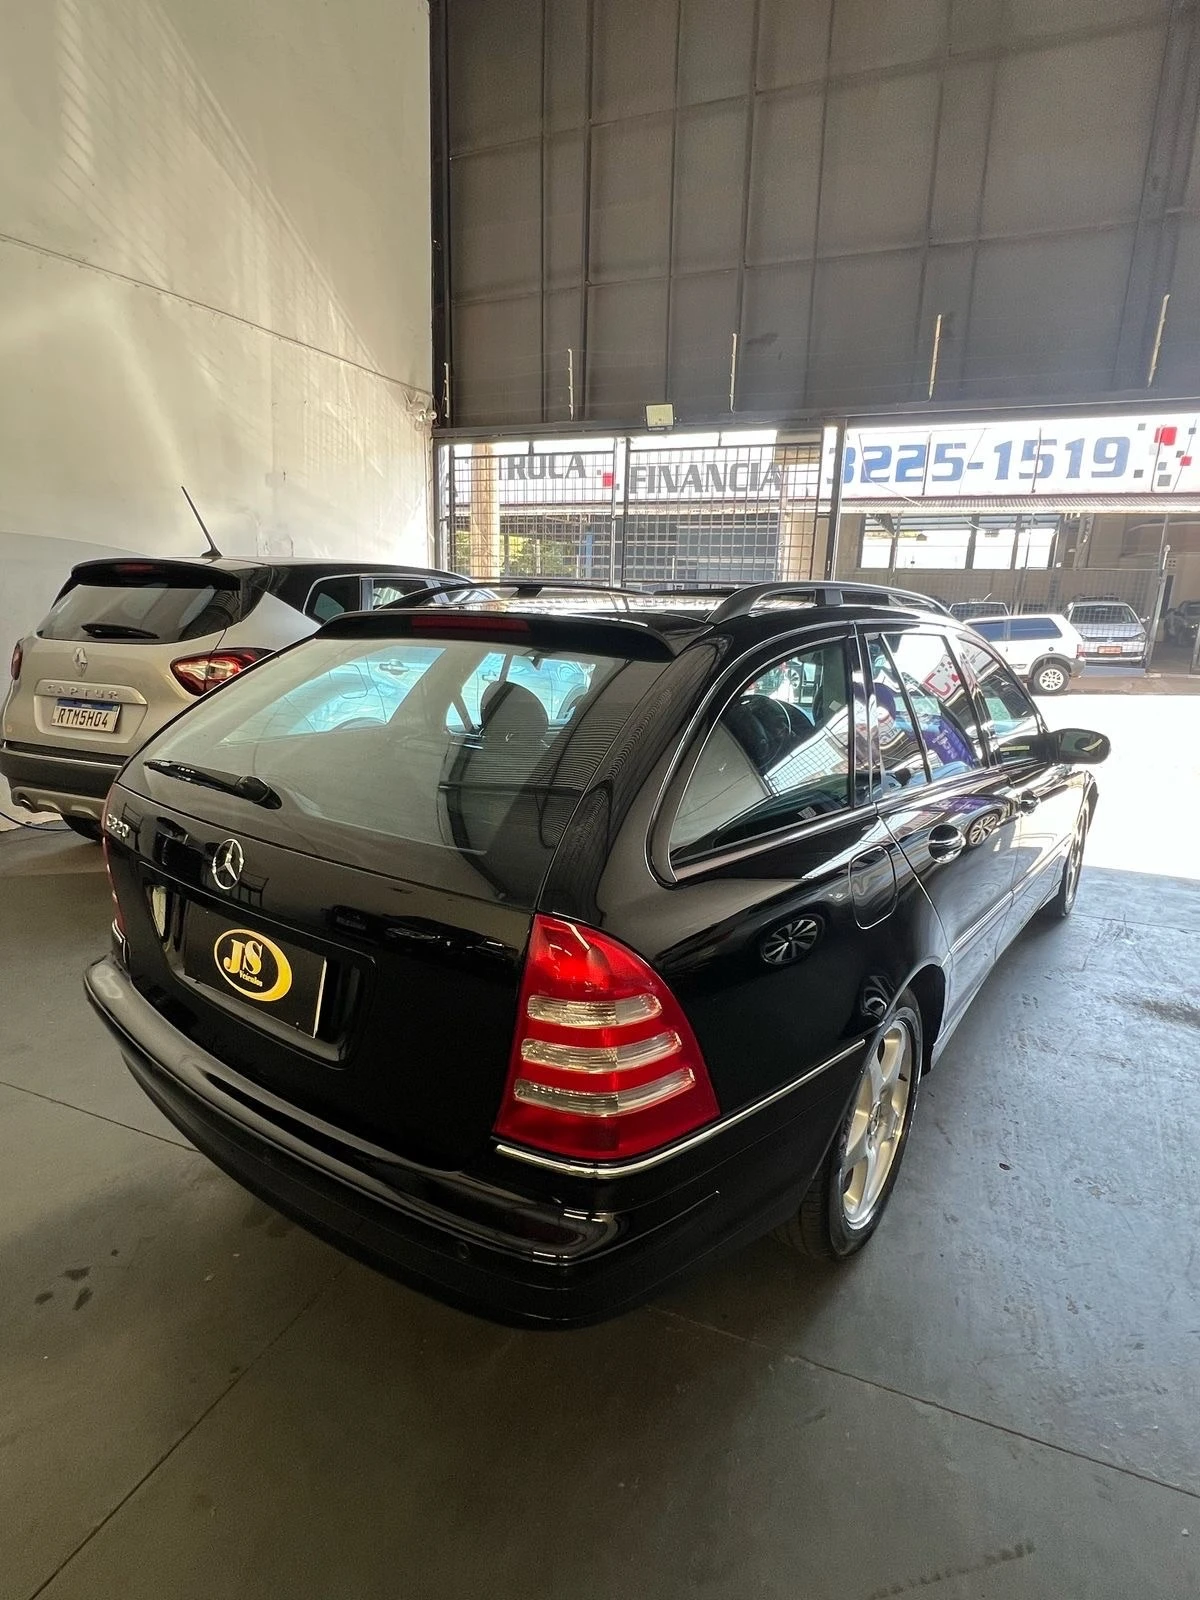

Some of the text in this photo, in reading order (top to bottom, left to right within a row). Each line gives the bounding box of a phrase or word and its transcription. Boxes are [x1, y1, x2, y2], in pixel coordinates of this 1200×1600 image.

[498, 454, 587, 480] ROCA
[629, 461, 783, 494] FINANCIA
[47, 684, 119, 700] CAPTUR
[56, 708, 110, 728] RTM5H04
[223, 938, 264, 976] JS
